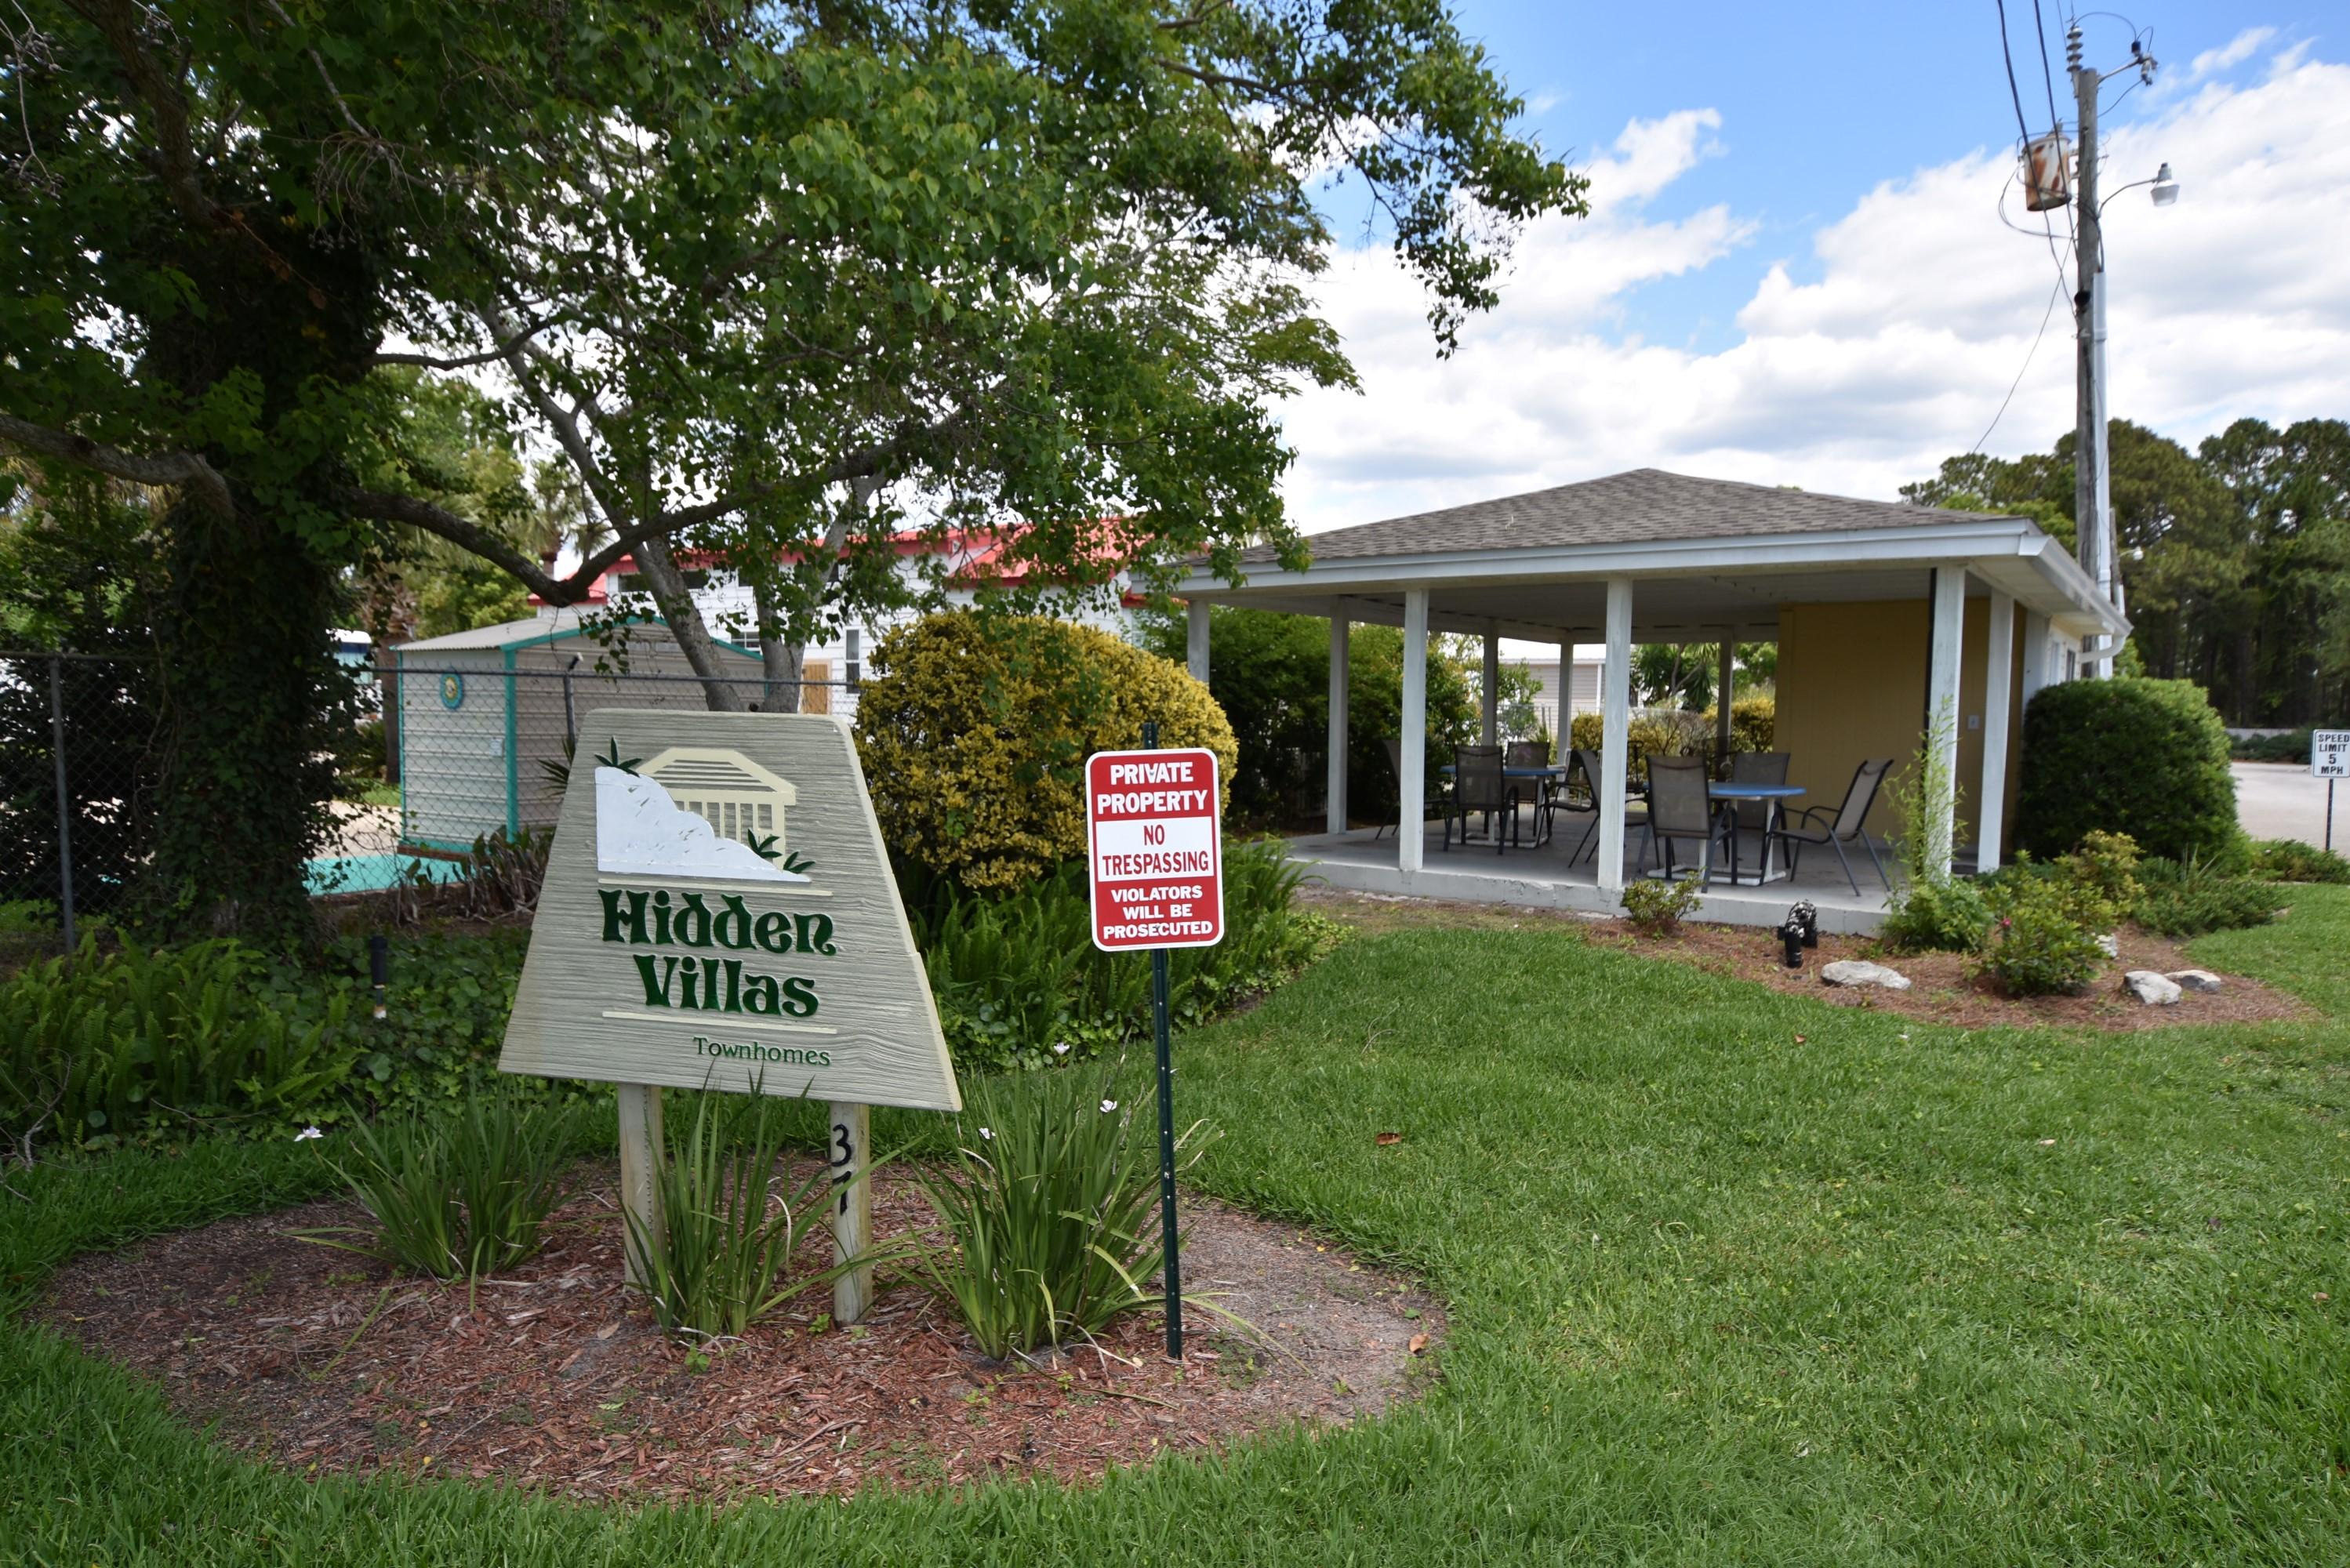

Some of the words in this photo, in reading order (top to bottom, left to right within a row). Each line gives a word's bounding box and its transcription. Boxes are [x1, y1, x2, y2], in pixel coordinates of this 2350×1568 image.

[2318, 734, 2350, 742] SPEED
[2319, 743, 2348, 753] LIMIT
[2328, 753, 2337, 764] 5
[1110, 761, 1193, 786] PRIVATE
[2320, 765, 2344, 775] MPH
[1097, 789, 1208, 815] PROPERTY
[1142, 824, 1165, 846] NO
[1102, 851, 1209, 877] TRESPASSING
[1110, 885, 1203, 903] VIOLATORS
[597, 889, 837, 956] Hidden
[1123, 906, 1164, 920] WILL
[1169, 904, 1193, 918] BE
[1103, 920, 1213, 940] PROSECUTED
[633, 954, 820, 1018] Villas
[692, 1036, 831, 1067] Townhomes
